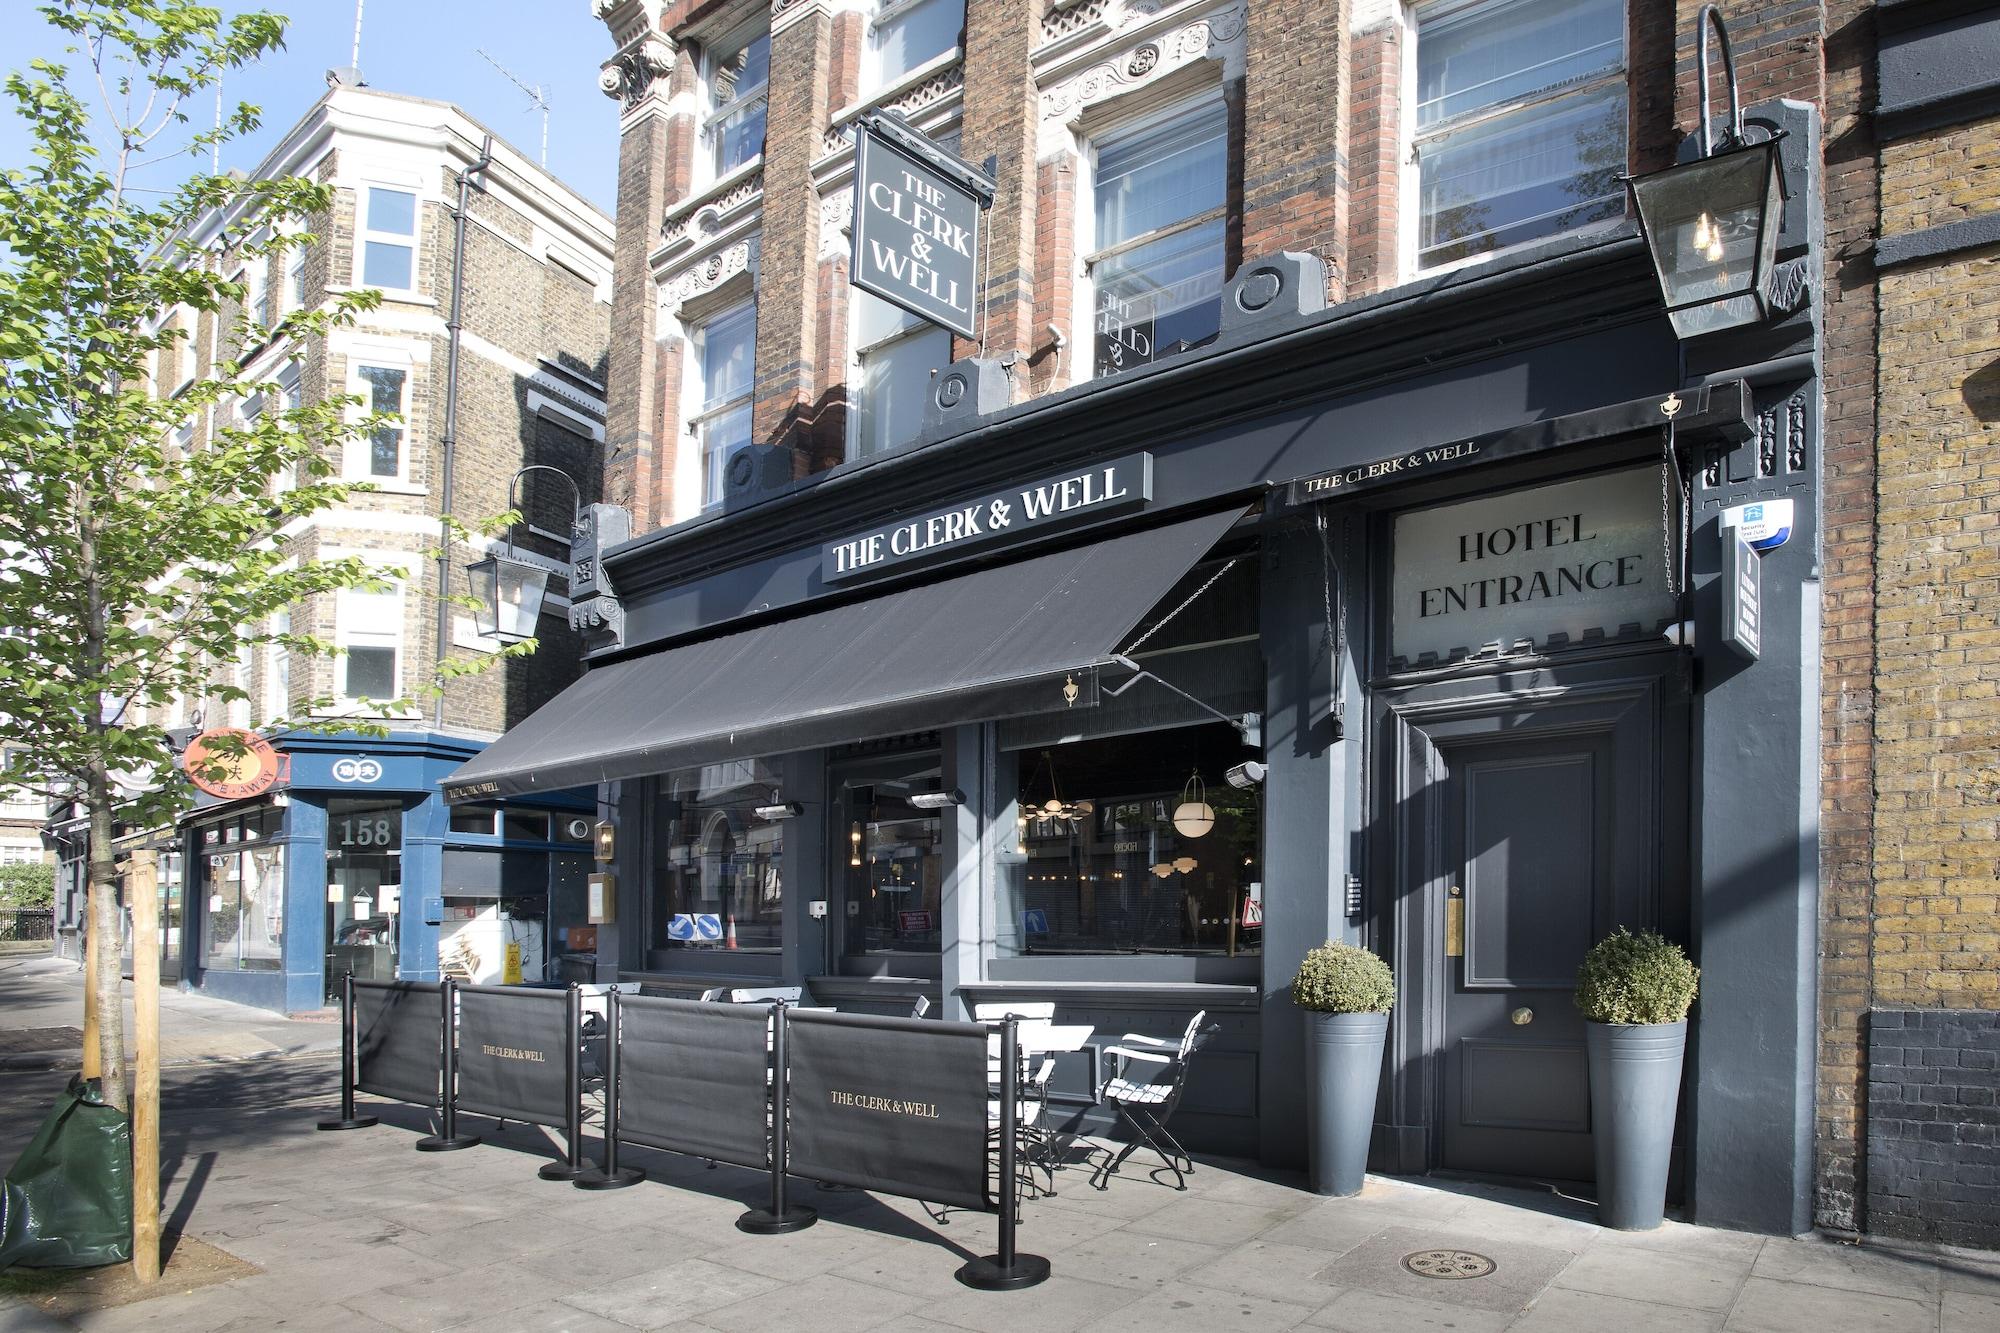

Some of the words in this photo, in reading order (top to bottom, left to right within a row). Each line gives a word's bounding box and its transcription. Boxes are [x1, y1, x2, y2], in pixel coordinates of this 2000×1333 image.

[901, 170, 946, 211] THE
[869, 182, 972, 259] CLERK
[910, 232, 933, 264] &
[869, 239, 968, 313] WELL
[1304, 474, 1343, 493] THE
[1345, 457, 1404, 484] CLERK
[1407, 455, 1422, 468] &
[1424, 441, 1480, 463] WELL
[832, 533, 885, 573] THE
[890, 505, 983, 555] CLERK
[988, 499, 1012, 531] &
[1020, 467, 1127, 520] WELL
[1457, 514, 1597, 563] HOTEL
[1418, 554, 1643, 618] ENTRANCE
[240, 770, 274, 794] AWAY
[341, 819, 390, 846] 158
[483, 1044, 496, 1056] THE
[495, 1046, 518, 1059] CLERK
[518, 1049, 525, 1060] &
[524, 1050, 545, 1062] WELL
[830, 1090, 854, 1106] THE
[855, 1094, 892, 1112] CLERK
[892, 1100, 902, 1113] &
[902, 1101, 940, 1118] WELL
